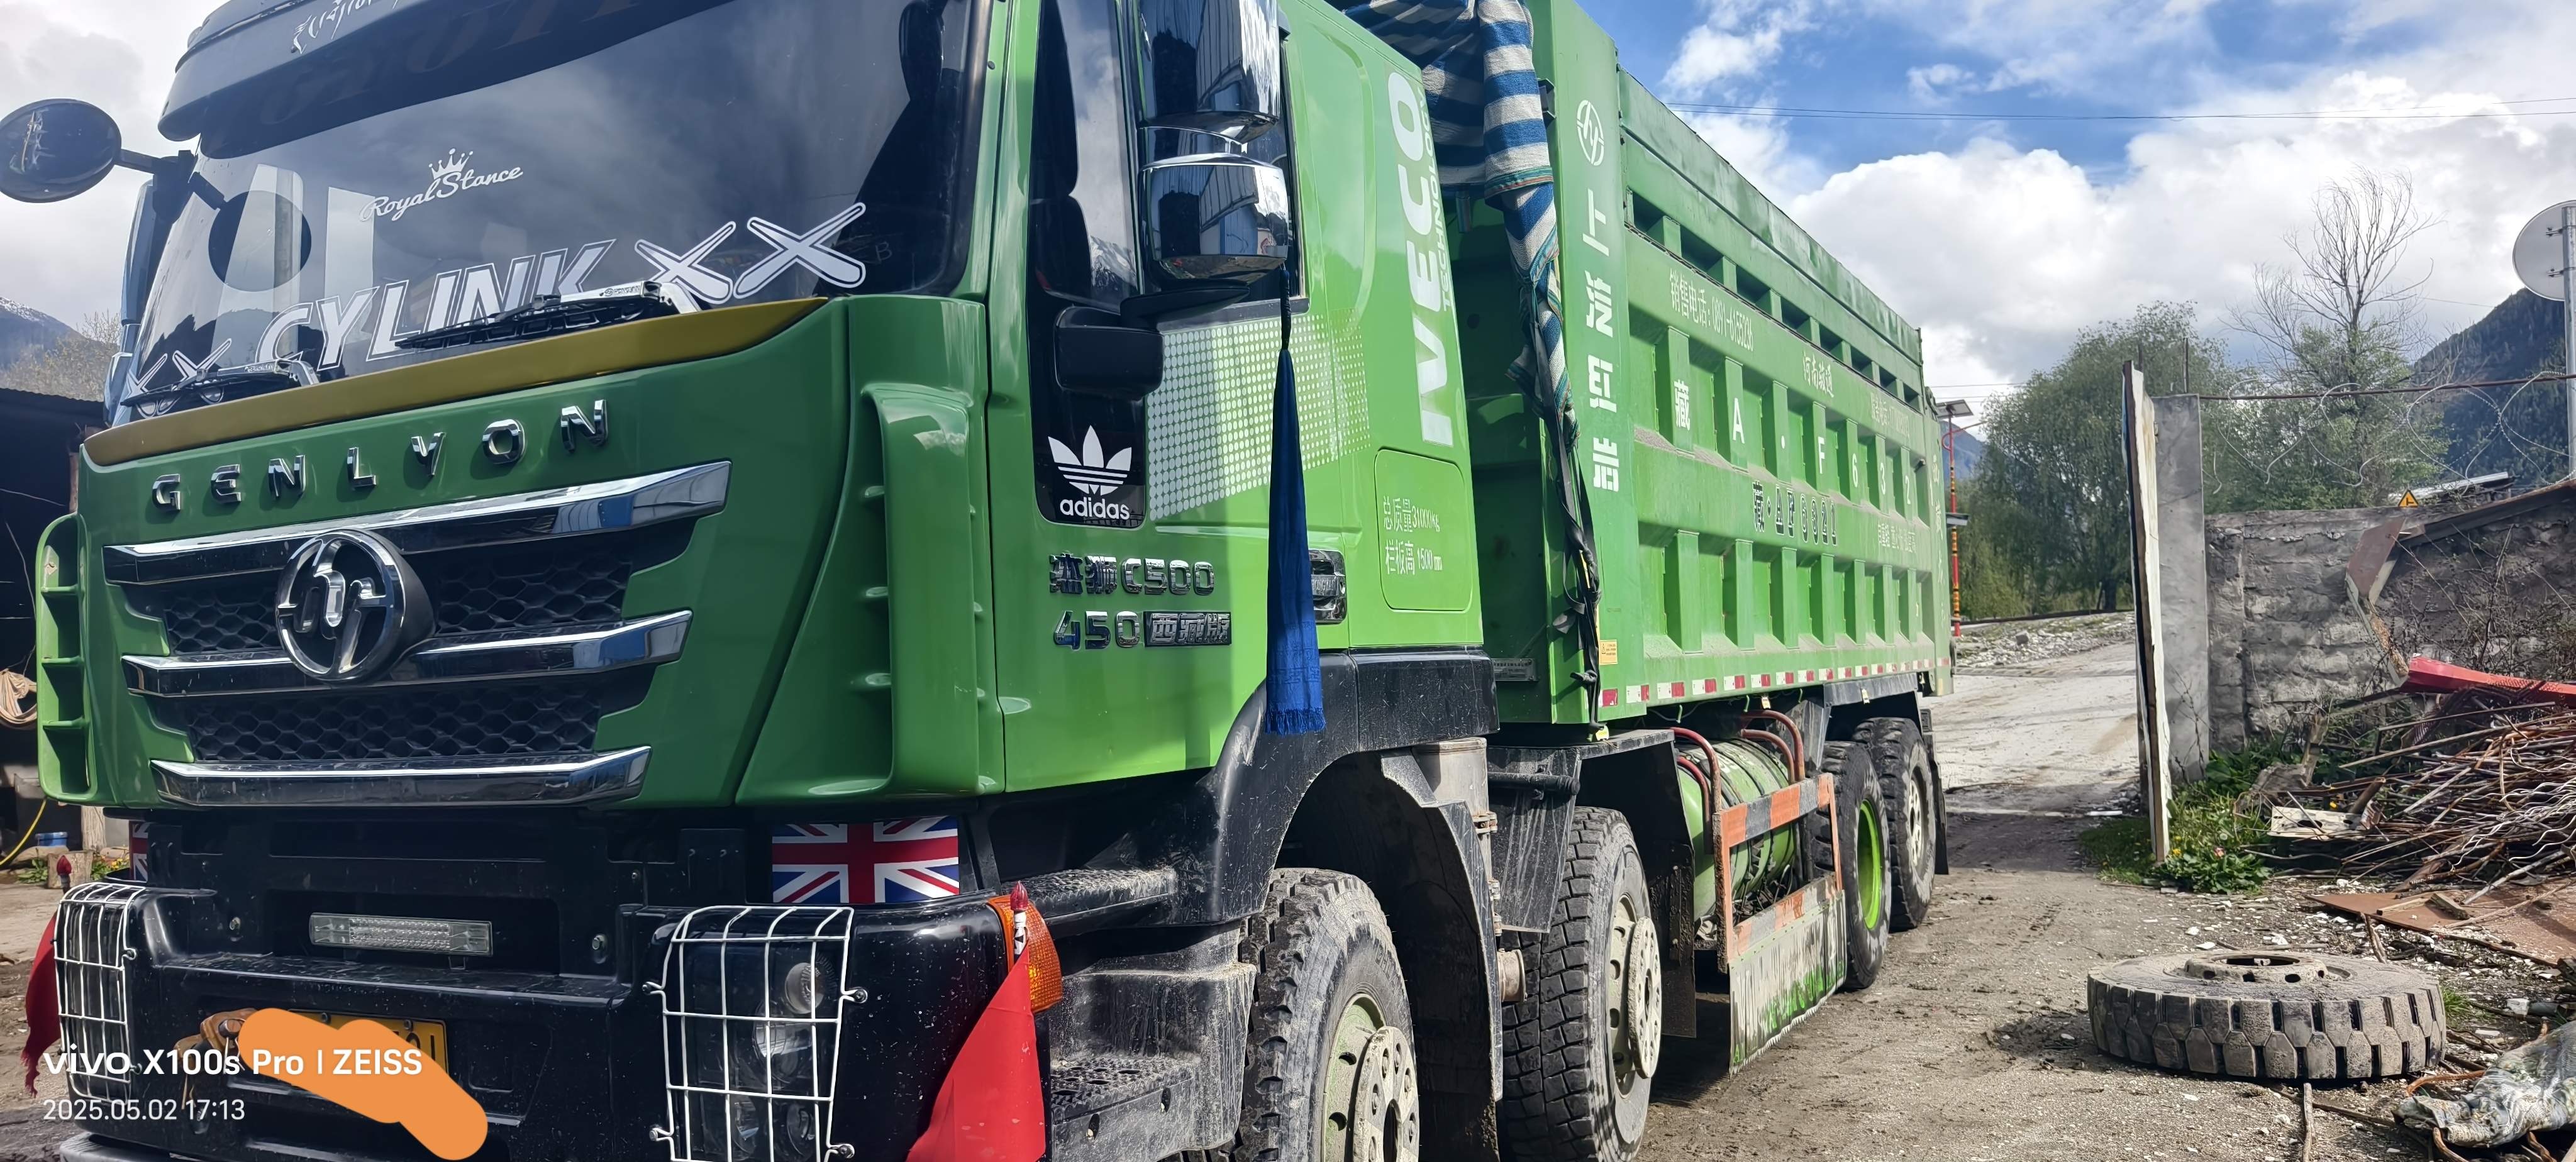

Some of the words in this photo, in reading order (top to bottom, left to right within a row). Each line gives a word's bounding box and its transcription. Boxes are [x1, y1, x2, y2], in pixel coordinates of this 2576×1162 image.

[1388, 72, 1453, 447] IVECO
[1418, 86, 1452, 311] TECHNOLOGY
[255, 238, 617, 371] CYLINK
[1582, 188, 1619, 494] 上汽红岩
[152, 399, 608, 510] GENLYON
[1060, 497, 1130, 520] adidas
[1054, 611, 1141, 650] 450
